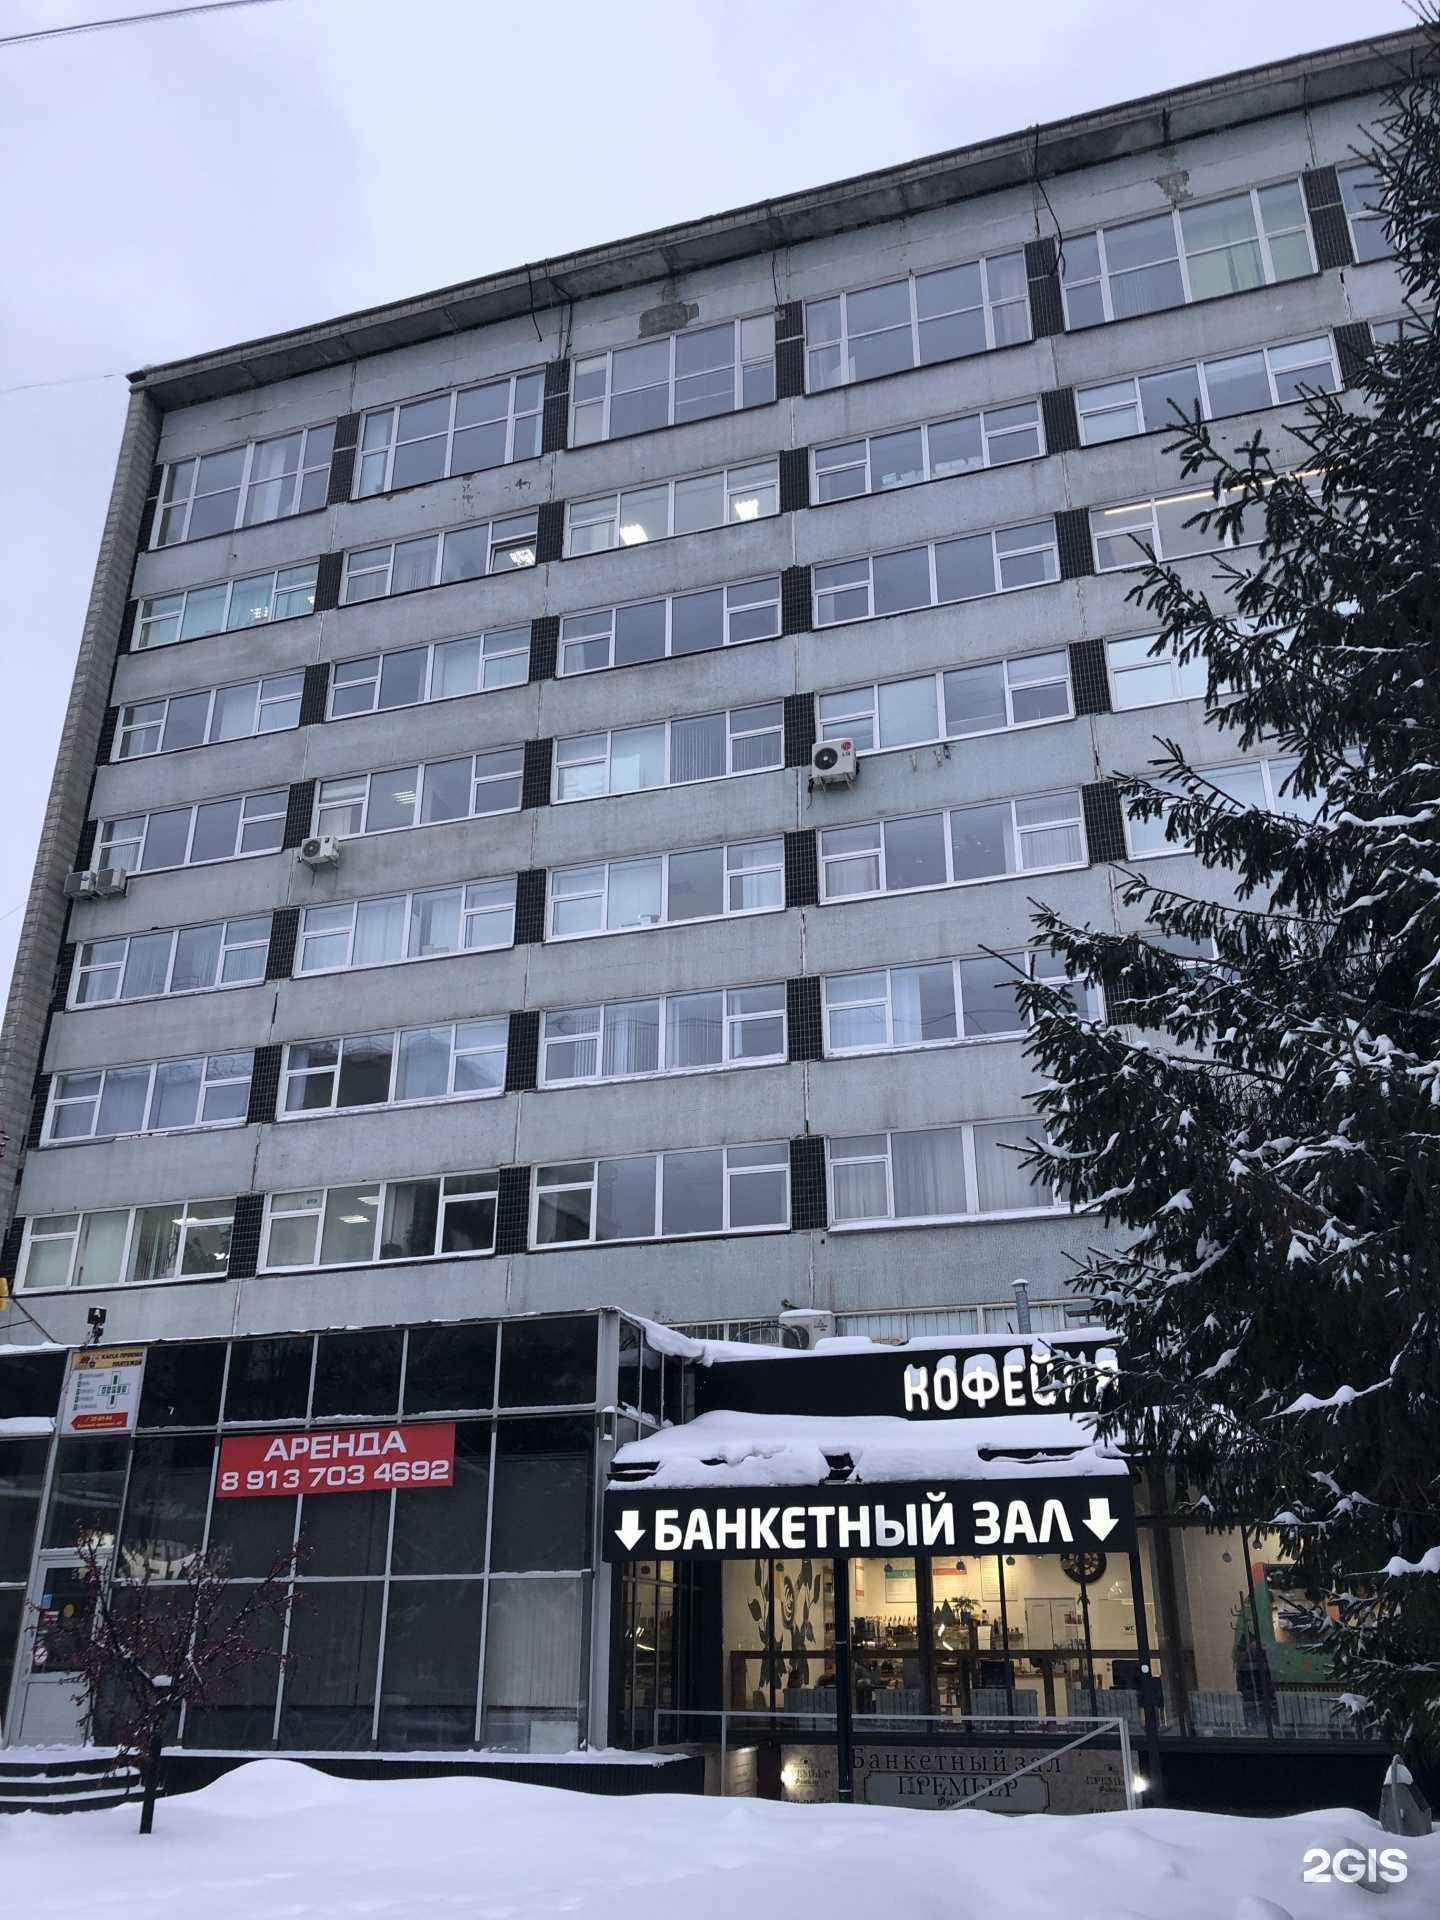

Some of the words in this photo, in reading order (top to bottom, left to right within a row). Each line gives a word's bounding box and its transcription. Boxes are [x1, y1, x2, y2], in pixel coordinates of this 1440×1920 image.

[264, 1431, 407, 1462] АРЕНДА
[221, 1471, 239, 1491] 8
[247, 1469, 300, 1490] 913
[308, 1464, 365, 1487] 703
[374, 1460, 449, 1482] 4692
[654, 1491, 955, 1551] БАНКЕТНЫЙ
[973, 1499, 1074, 1545] ЗАЛ
[852, 1747, 1008, 1772] Банкетный
[1014, 1756, 1061, 1773] зал
